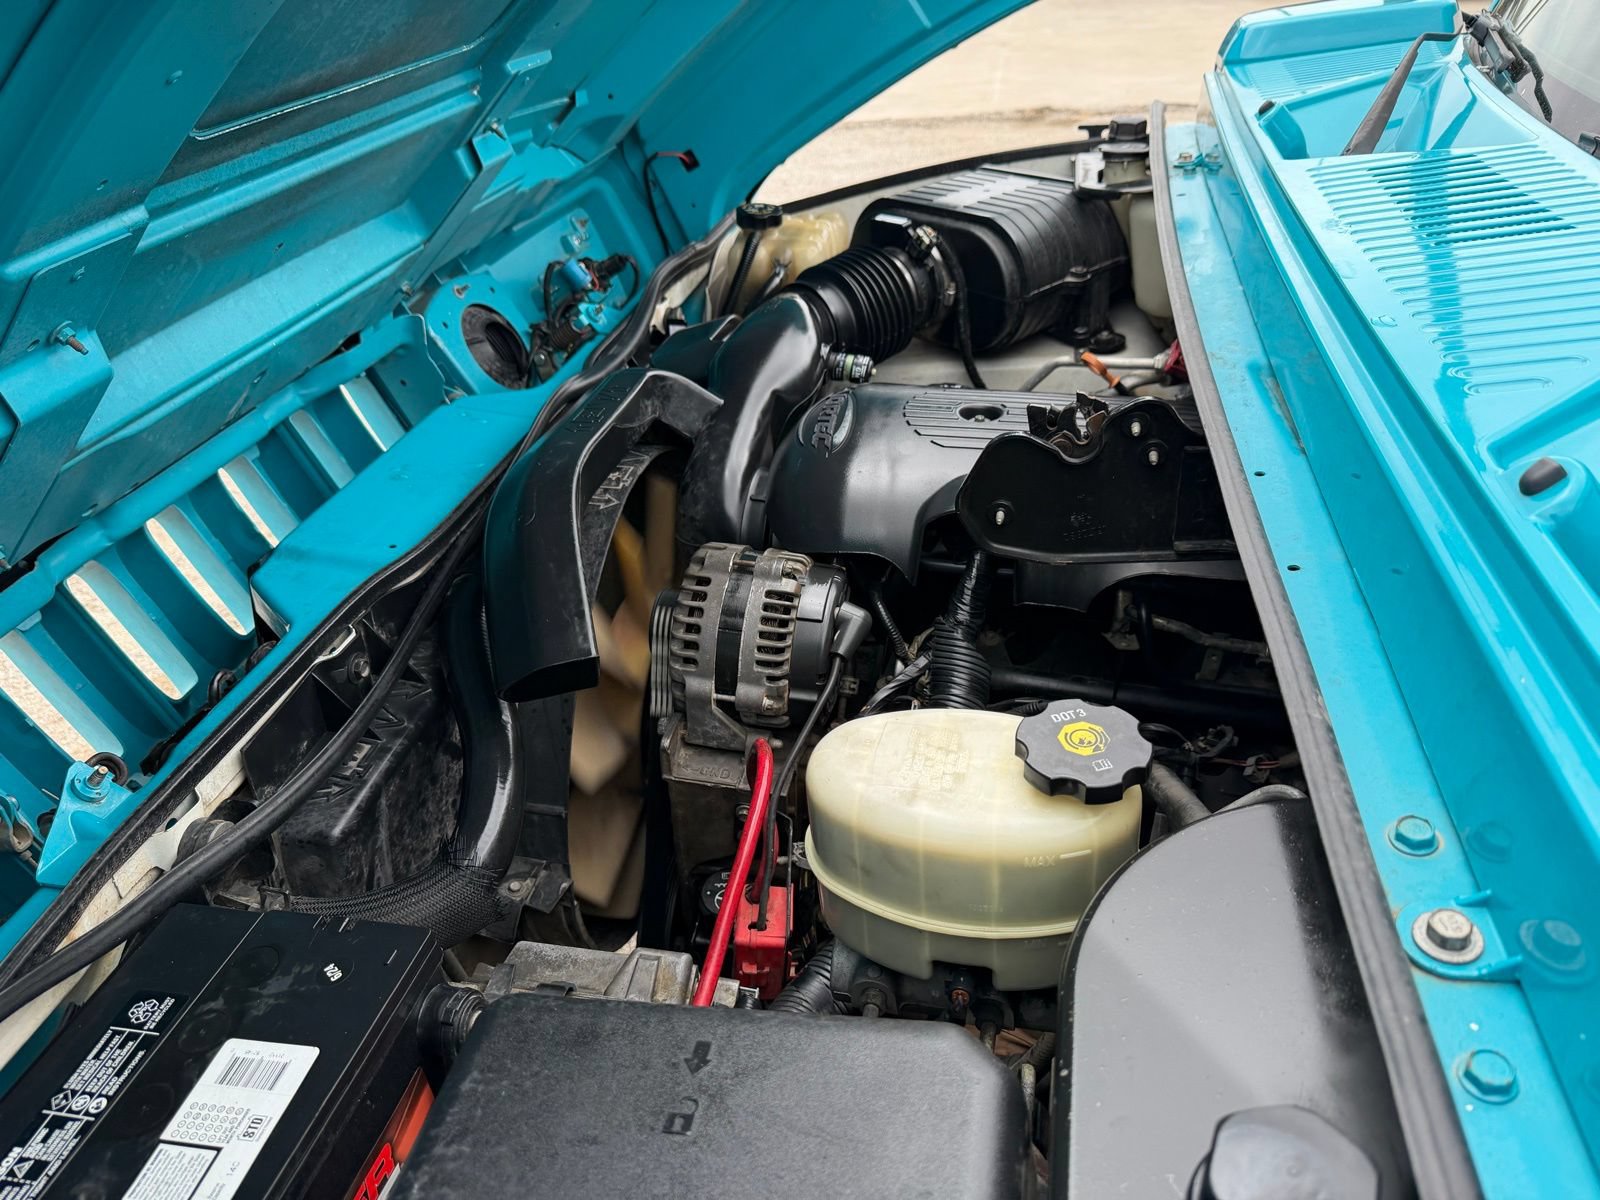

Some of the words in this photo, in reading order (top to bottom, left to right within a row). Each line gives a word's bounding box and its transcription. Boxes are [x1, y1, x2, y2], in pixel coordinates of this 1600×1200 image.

[1050, 710, 1076, 723] DOT
[1076, 708, 1087, 717] 3
[1023, 855, 1056, 868] MAX
